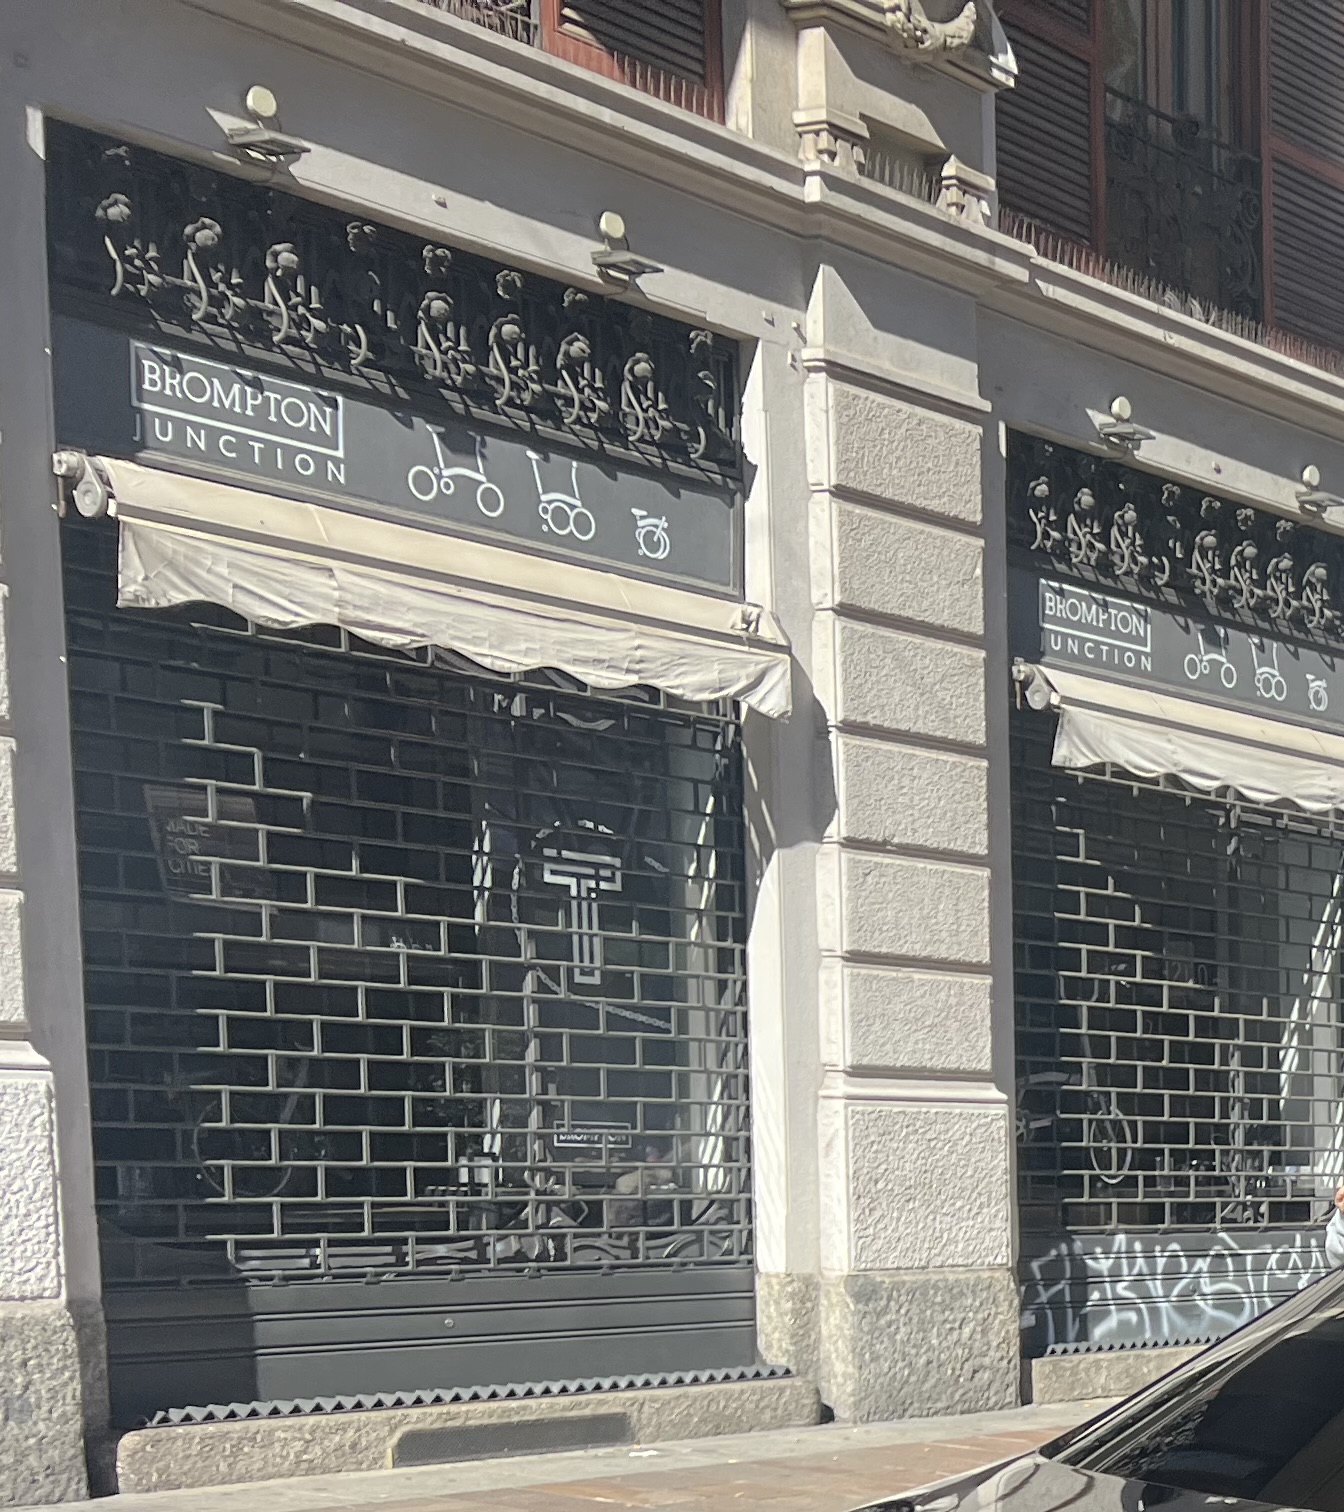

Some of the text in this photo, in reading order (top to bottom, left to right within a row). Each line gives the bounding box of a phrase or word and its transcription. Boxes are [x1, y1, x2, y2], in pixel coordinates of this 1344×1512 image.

[141, 360, 334, 437] BROMPTON
[132, 413, 346, 485] JUNCTION
[1044, 592, 1145, 637] BROMPTON
